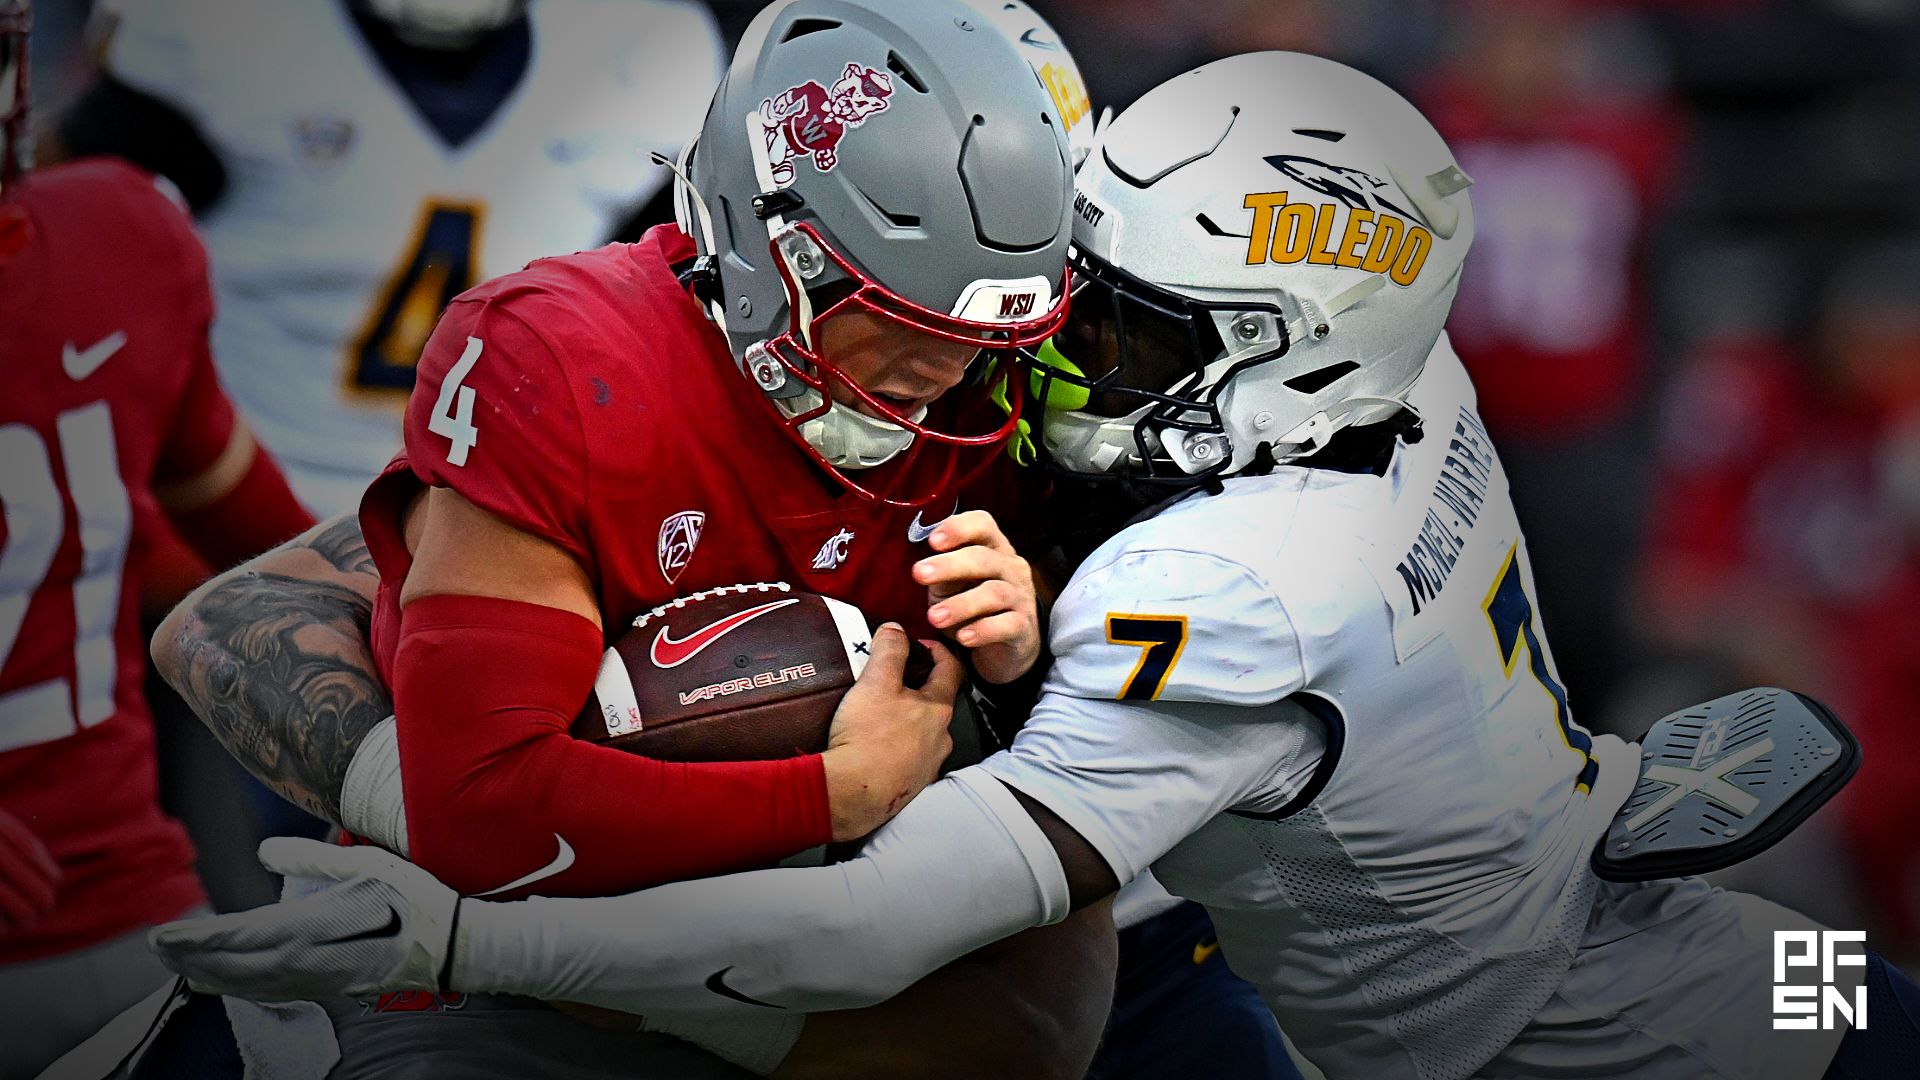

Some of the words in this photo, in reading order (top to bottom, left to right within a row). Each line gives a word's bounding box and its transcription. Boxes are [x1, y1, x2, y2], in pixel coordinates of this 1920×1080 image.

[1083, 202, 1105, 227] CITY
[1243, 191, 1433, 287] TOLEDO
[1000, 293, 1036, 316] WSU
[428, 336, 484, 467] 4
[661, 515, 703, 559] PAC
[665, 541, 688, 570] 12
[1104, 611, 1190, 702] 7
[679, 677, 754, 705] VAPOR
[754, 663, 817, 688] ELITE
